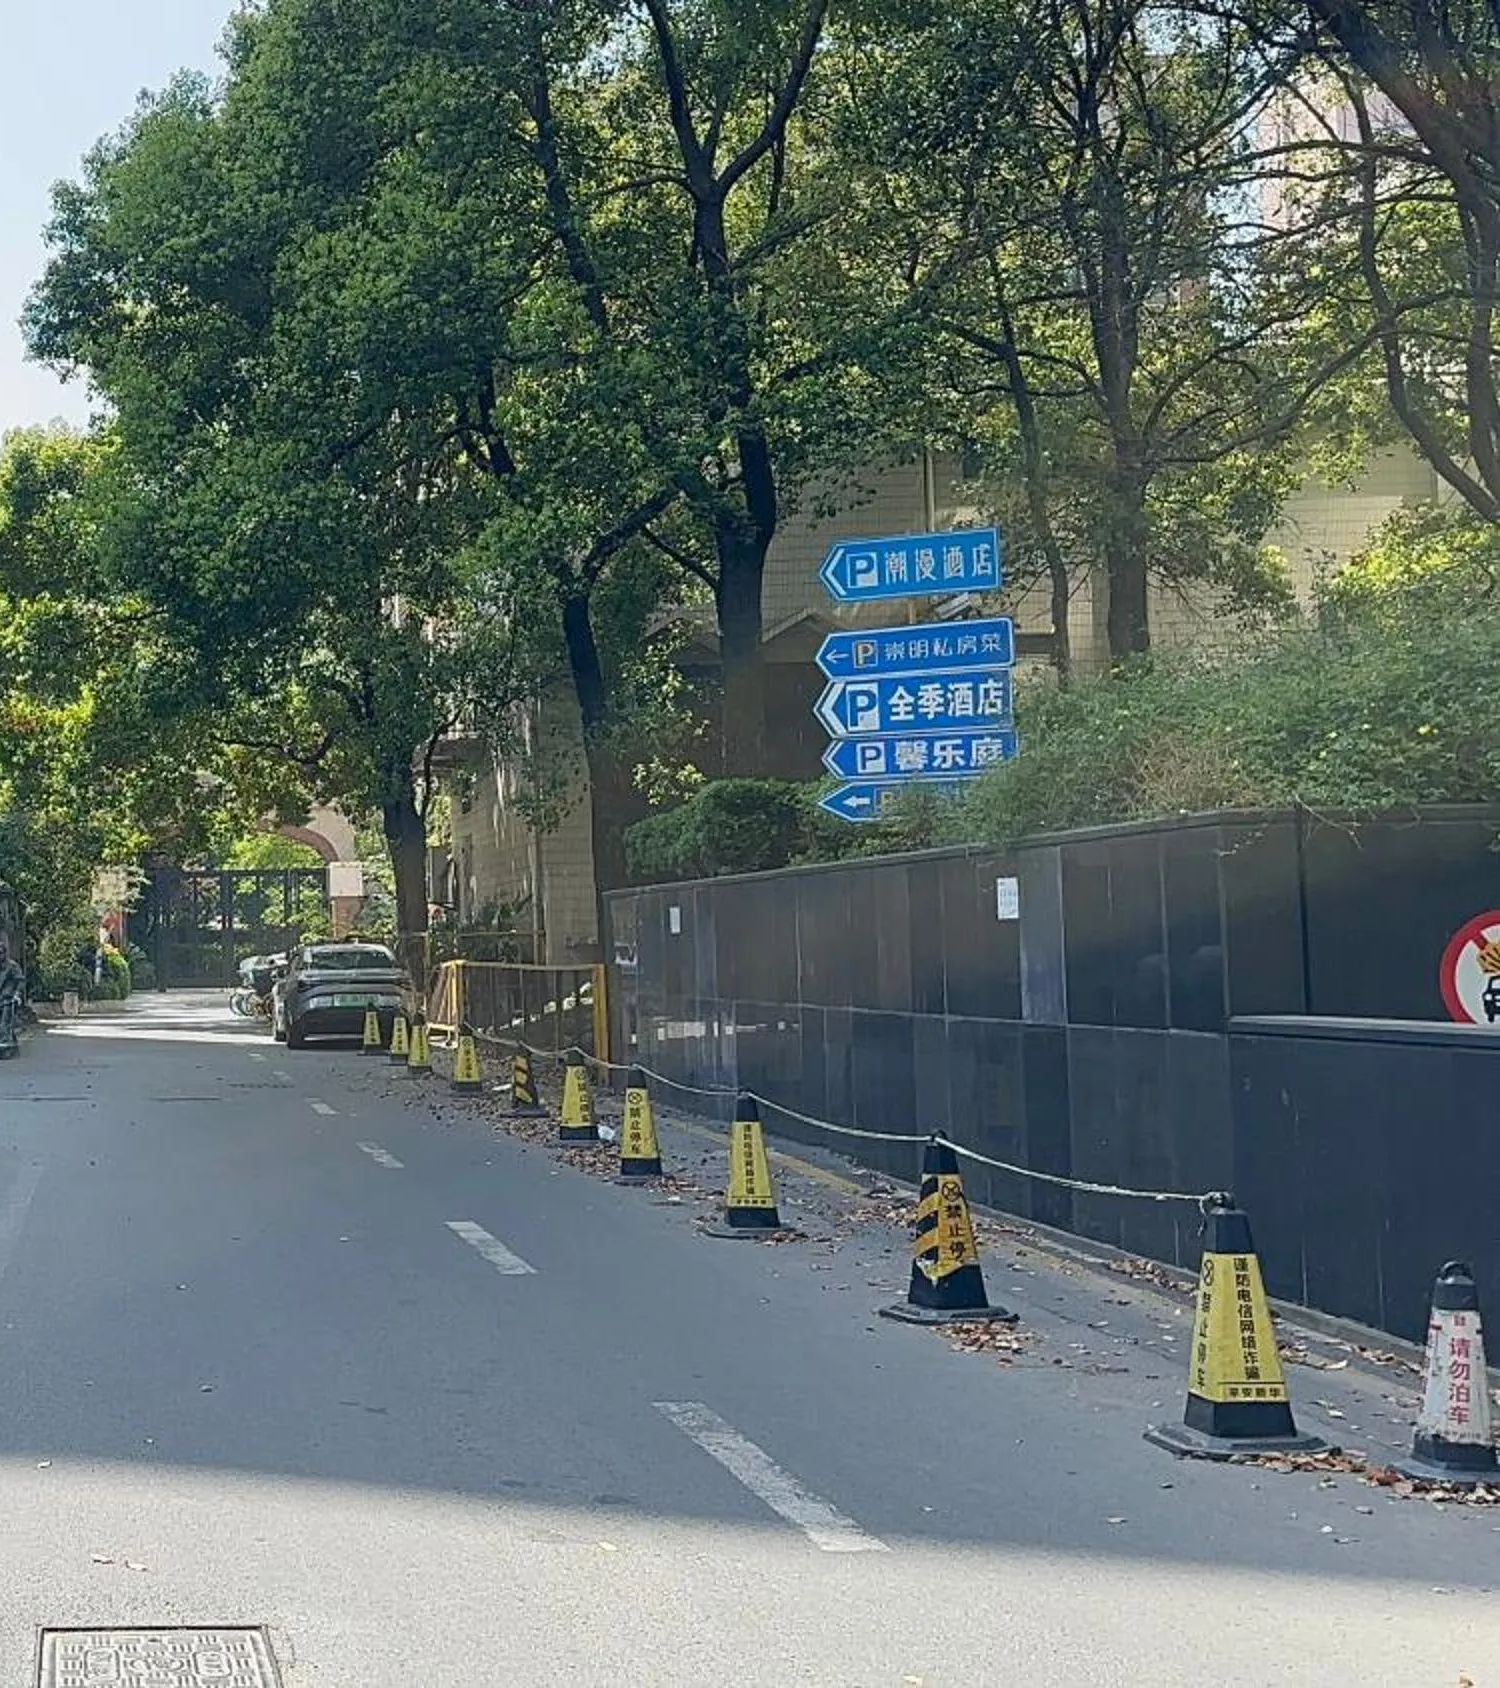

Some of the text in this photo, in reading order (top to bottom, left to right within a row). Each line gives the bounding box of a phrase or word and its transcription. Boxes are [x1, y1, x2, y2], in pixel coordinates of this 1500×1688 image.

[884, 543, 993, 585] 潮漫酒店
[888, 678, 1003, 721] 全季酒店
[894, 737, 1003, 771] 馨乐庭
[1233, 1257, 1260, 1380] 谨防电信网络诈骗
[1448, 1337, 1471, 1424] 请勿泊车
